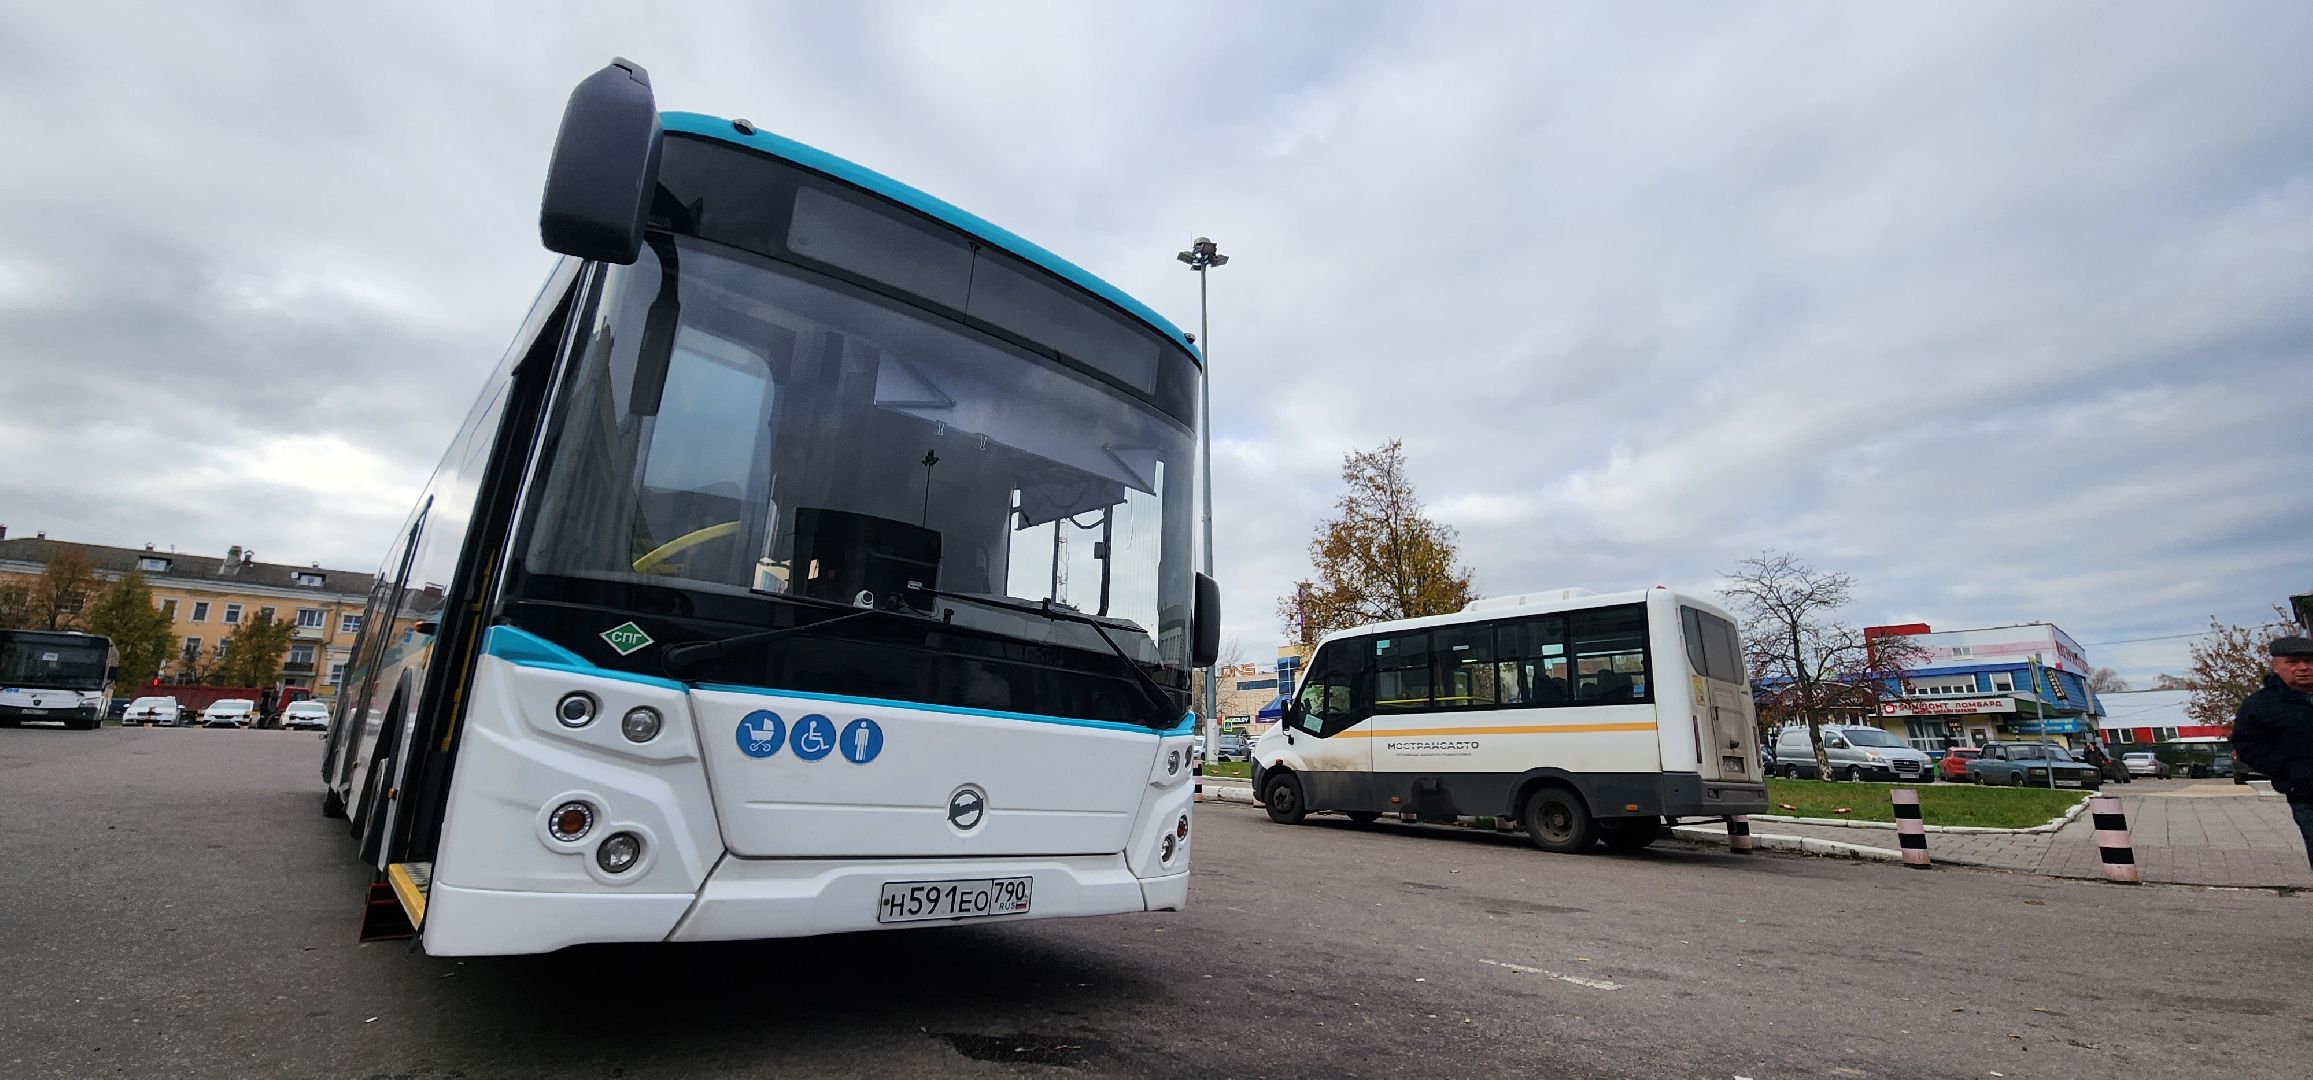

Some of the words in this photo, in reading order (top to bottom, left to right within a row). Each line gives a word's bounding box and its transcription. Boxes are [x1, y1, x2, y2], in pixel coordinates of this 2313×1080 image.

[611, 631, 642, 645] СПГ
[1220, 663, 1255, 678] DNS
[1955, 701, 2003, 709] ЛОМБАРД
[994, 880, 1026, 904] 790
[999, 902, 1015, 911] RUS
